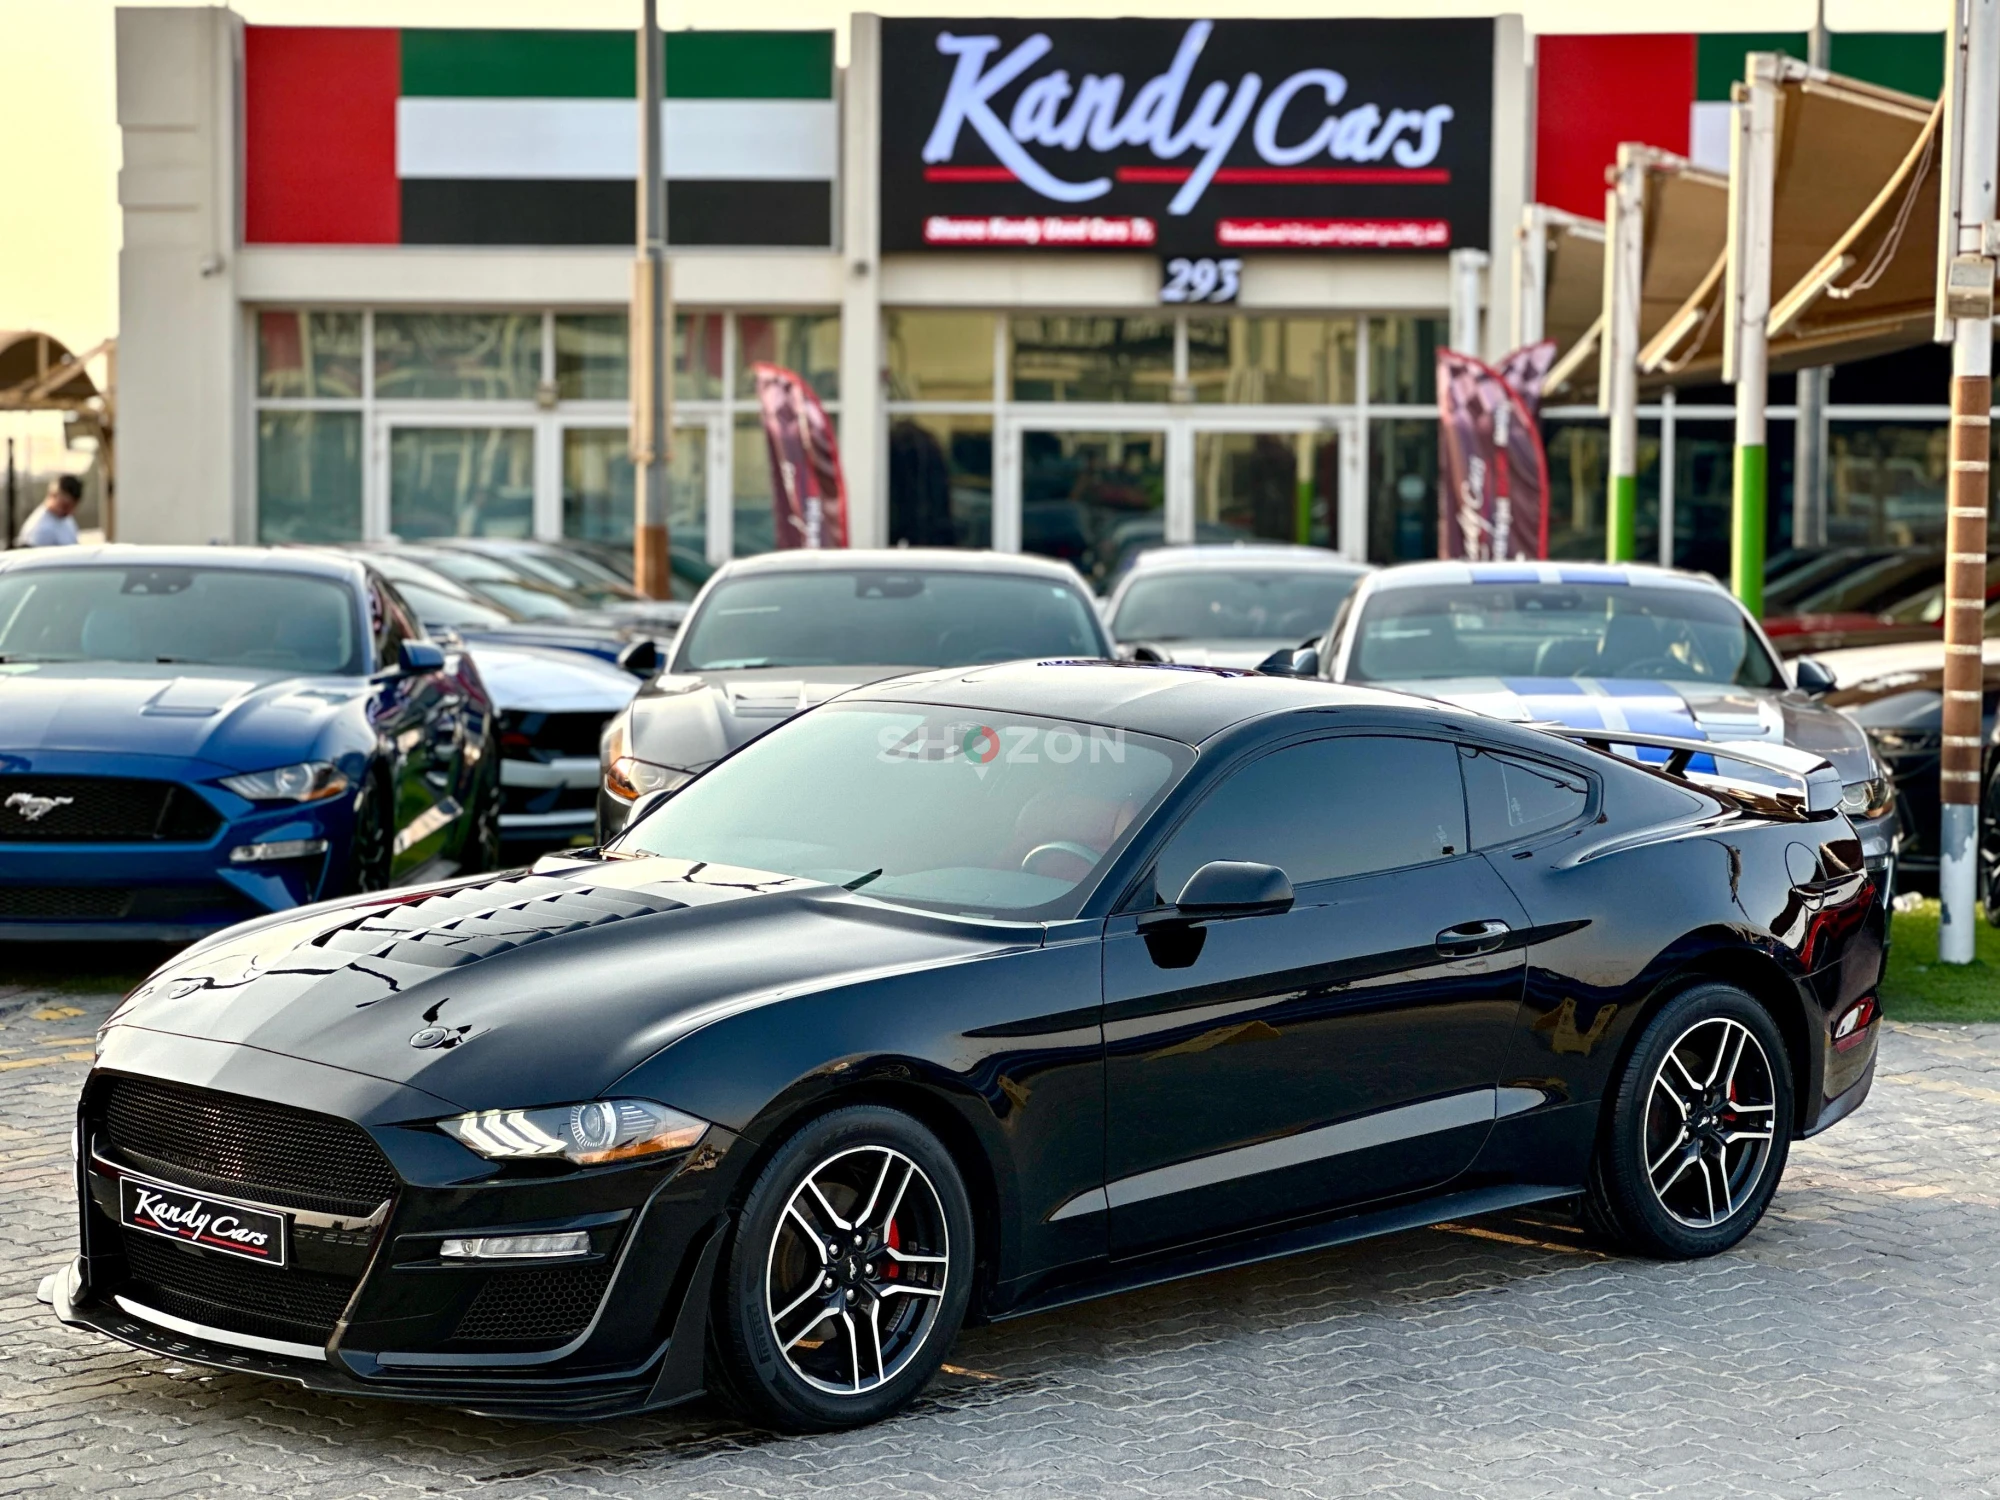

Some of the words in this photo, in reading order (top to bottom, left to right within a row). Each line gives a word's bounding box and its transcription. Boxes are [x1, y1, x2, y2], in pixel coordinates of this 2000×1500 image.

[922, 19, 1262, 214] Kandy
[1252, 68, 1454, 168] Cars
[1158, 257, 1243, 303] 295
[133, 1187, 211, 1241] Kandy
[210, 1215, 269, 1247] Cars
